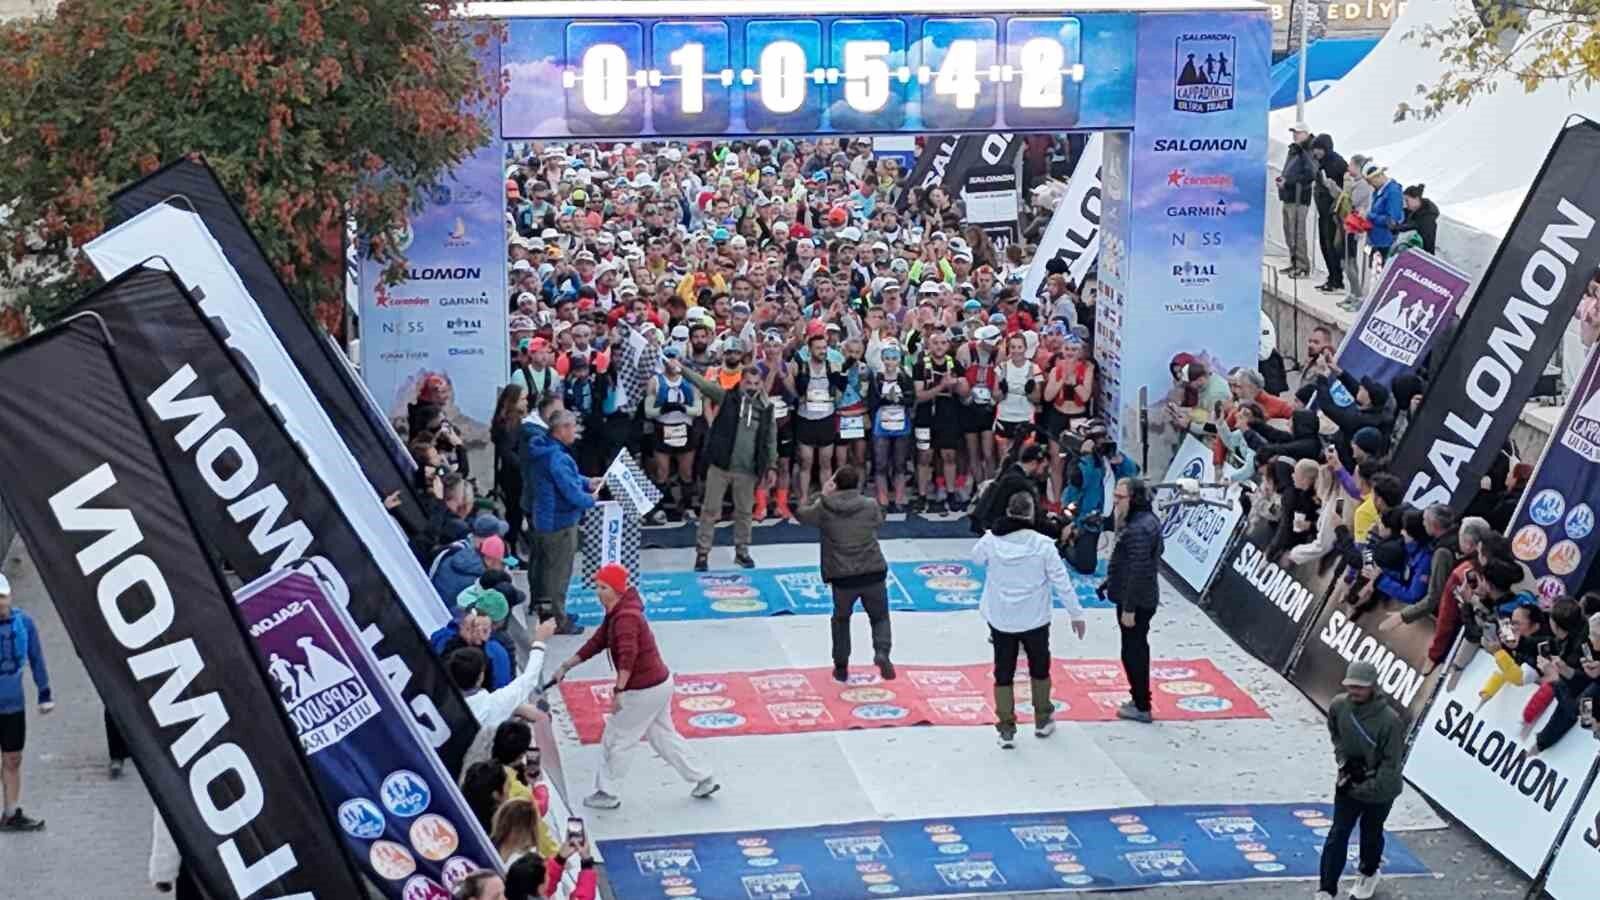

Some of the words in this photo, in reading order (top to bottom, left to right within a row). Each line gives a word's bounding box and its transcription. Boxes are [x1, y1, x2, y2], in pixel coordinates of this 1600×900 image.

[1153, 138, 1248, 152] SALOMON
[1167, 206, 1226, 217] GARMIN
[402, 267, 481, 281] ALOMON
[1402, 268, 1451, 298] SALOMON
[439, 297, 489, 306] GARMIN
[1402, 197, 1597, 512] SALOMON
[1232, 541, 1314, 624] SALOMON
[1320, 610, 1425, 708] SALOMON
[1434, 699, 1569, 813] SALOMON
